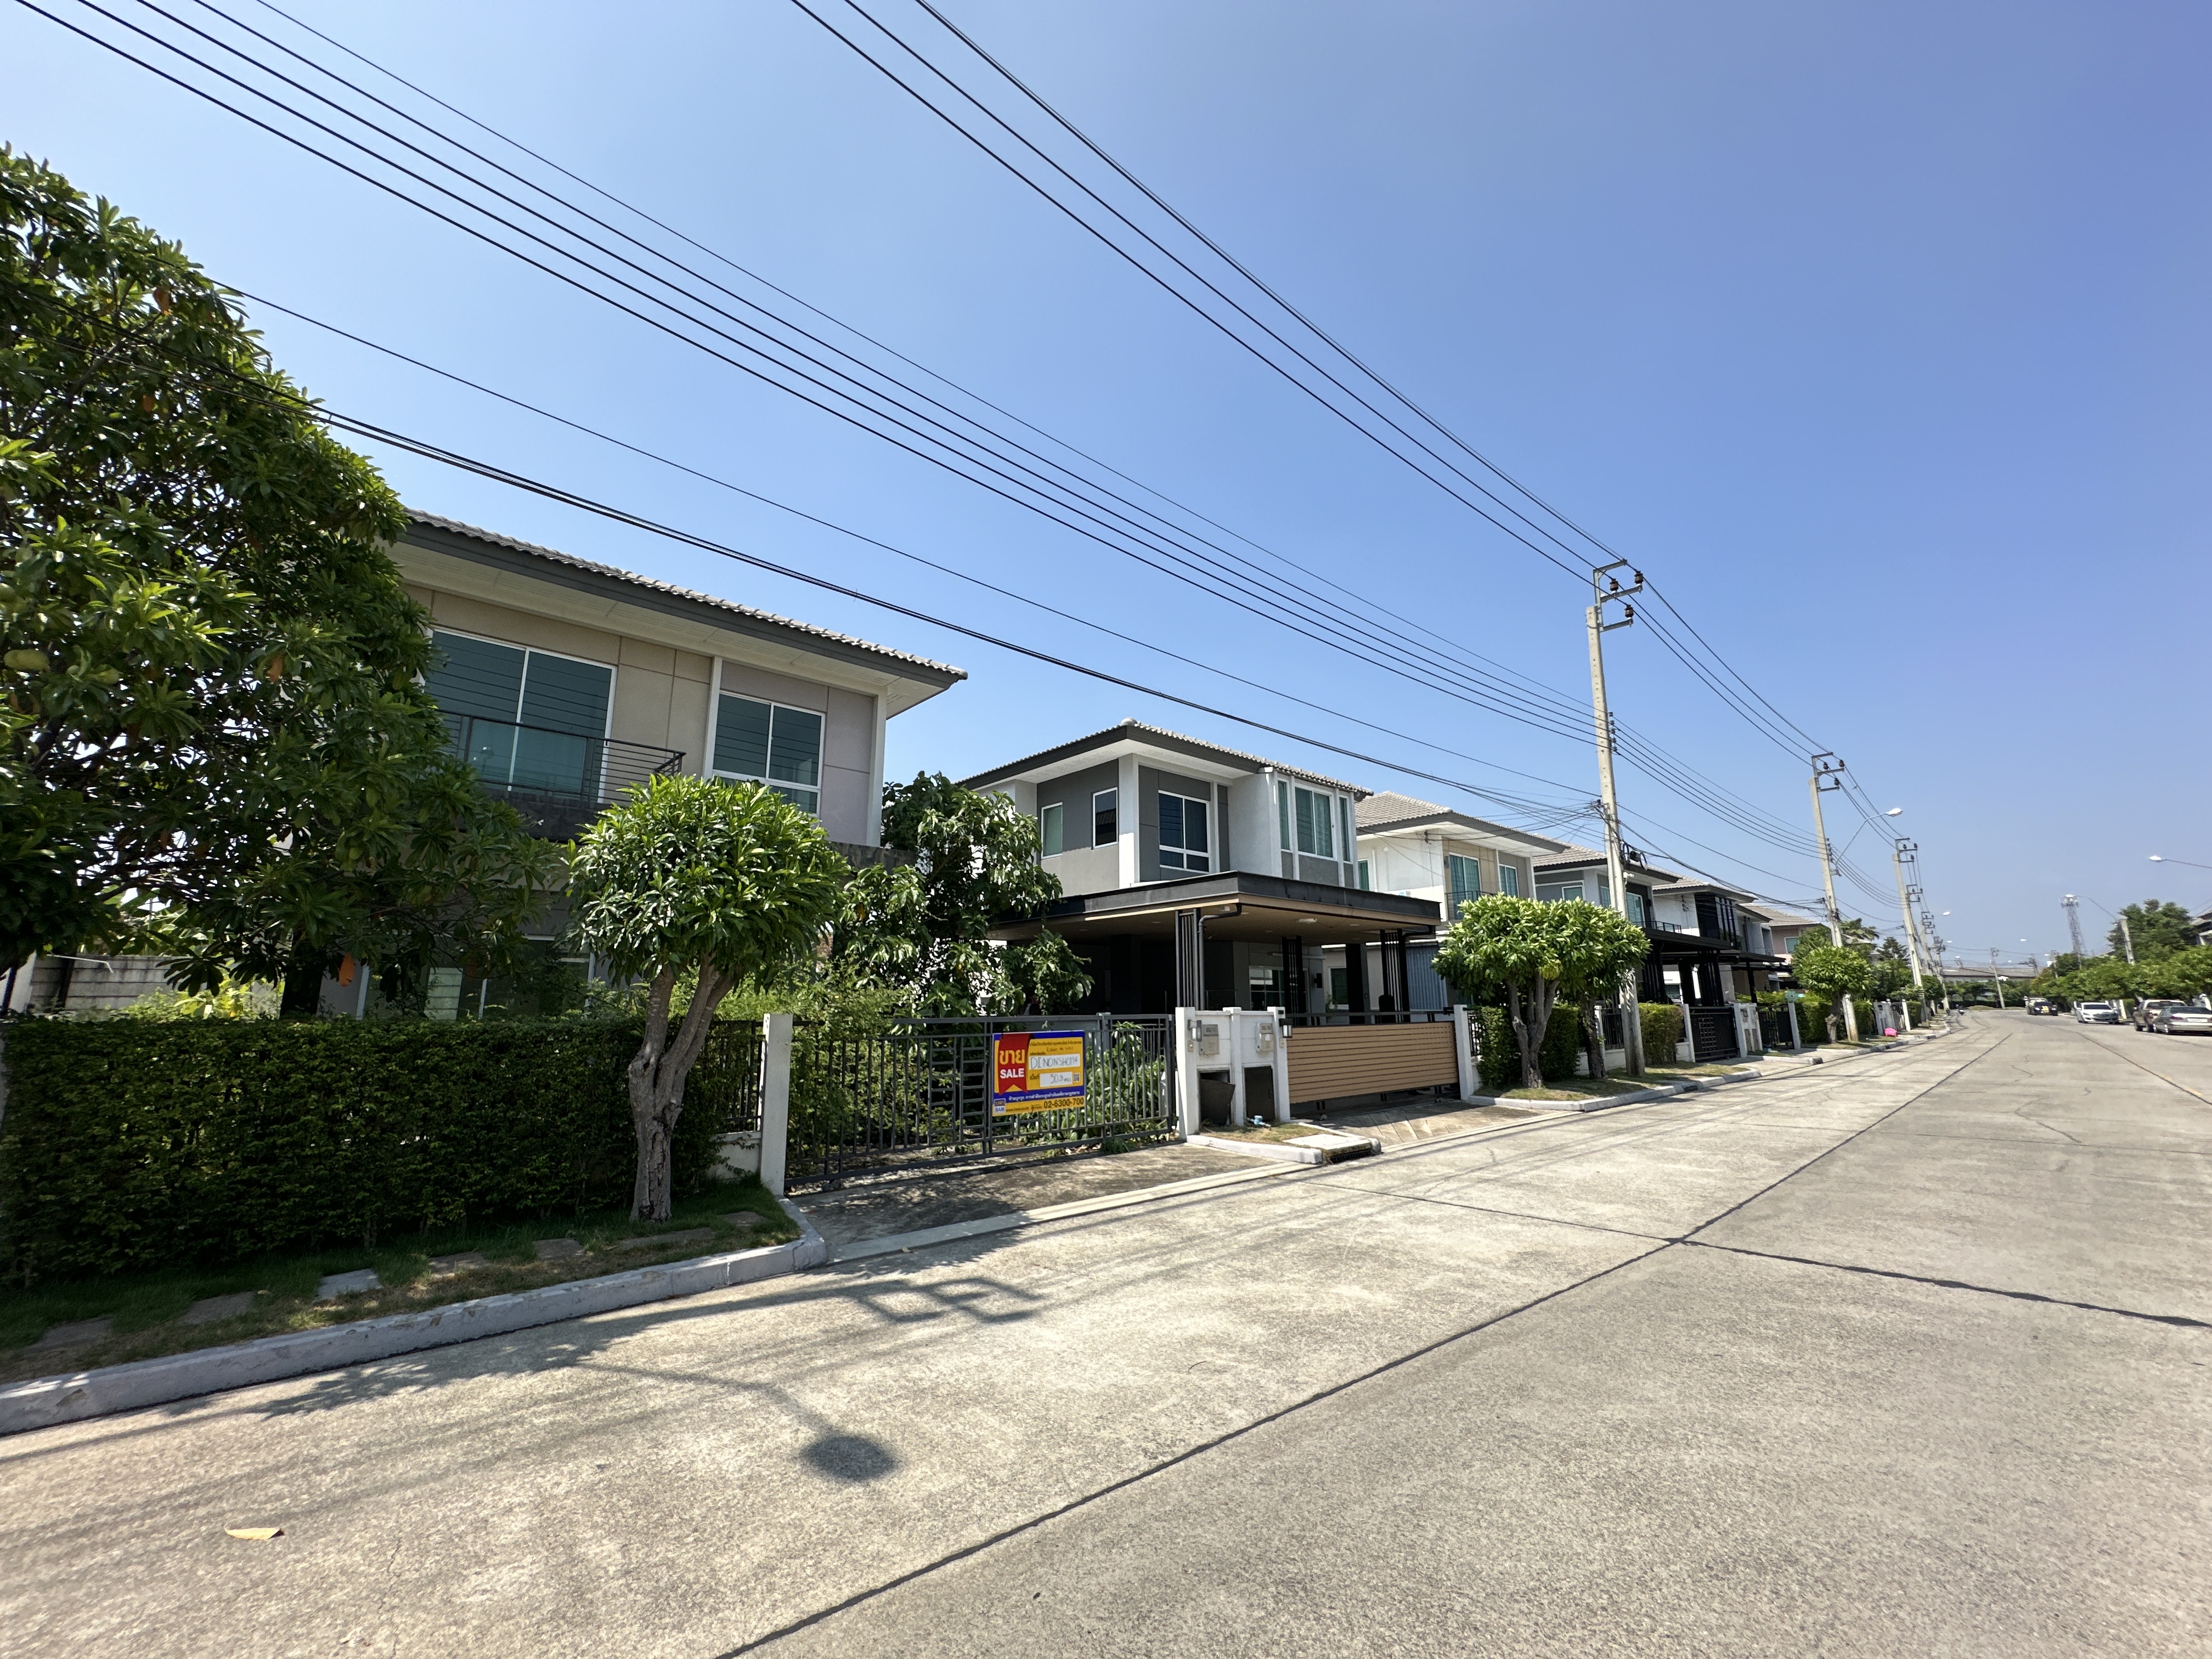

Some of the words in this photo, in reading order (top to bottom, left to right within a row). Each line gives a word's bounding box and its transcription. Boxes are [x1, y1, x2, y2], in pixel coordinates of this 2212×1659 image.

[999, 1049, 1025, 1065] ขาย
[1000, 1068, 1024, 1079] SALE
[1043, 1097, 1084, 1108] 02-6300-700
